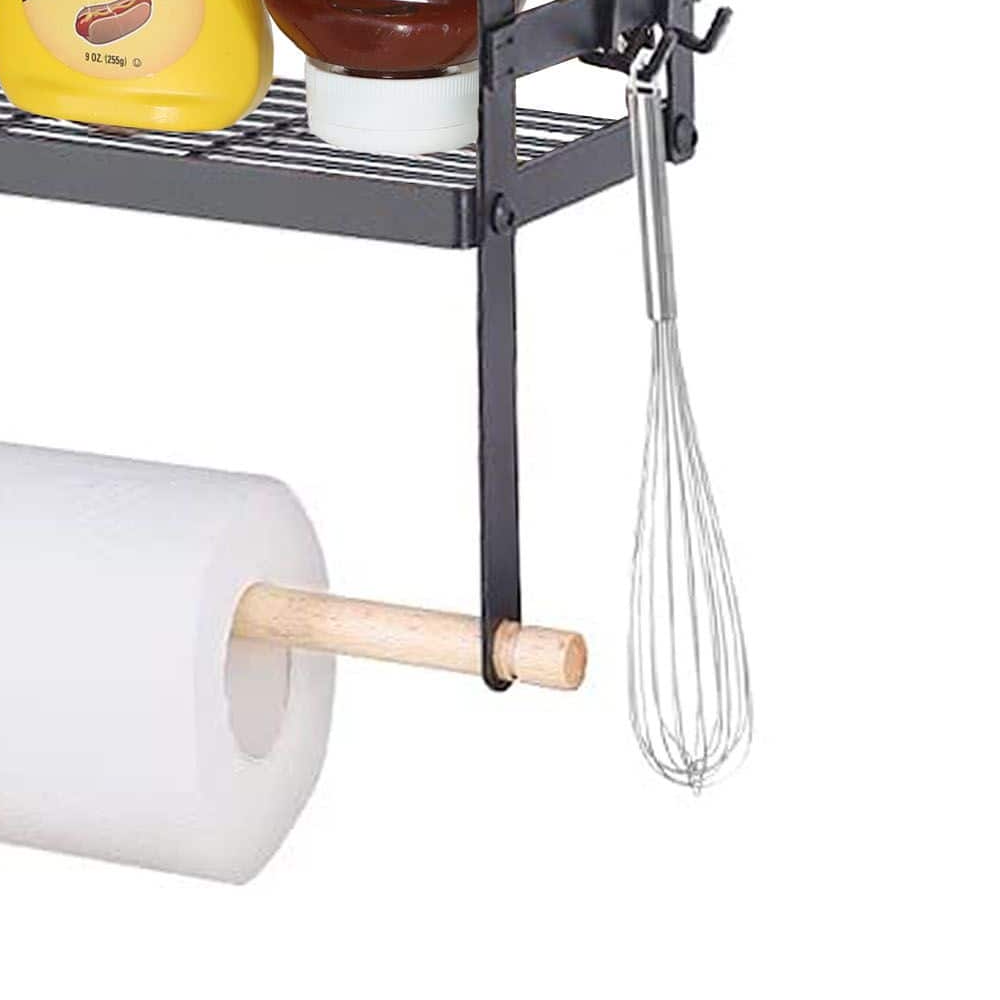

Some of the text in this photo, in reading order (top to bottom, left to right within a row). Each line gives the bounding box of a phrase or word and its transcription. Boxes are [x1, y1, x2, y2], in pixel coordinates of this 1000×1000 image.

[85, 52, 128, 68] 9 OZ. (255g)
